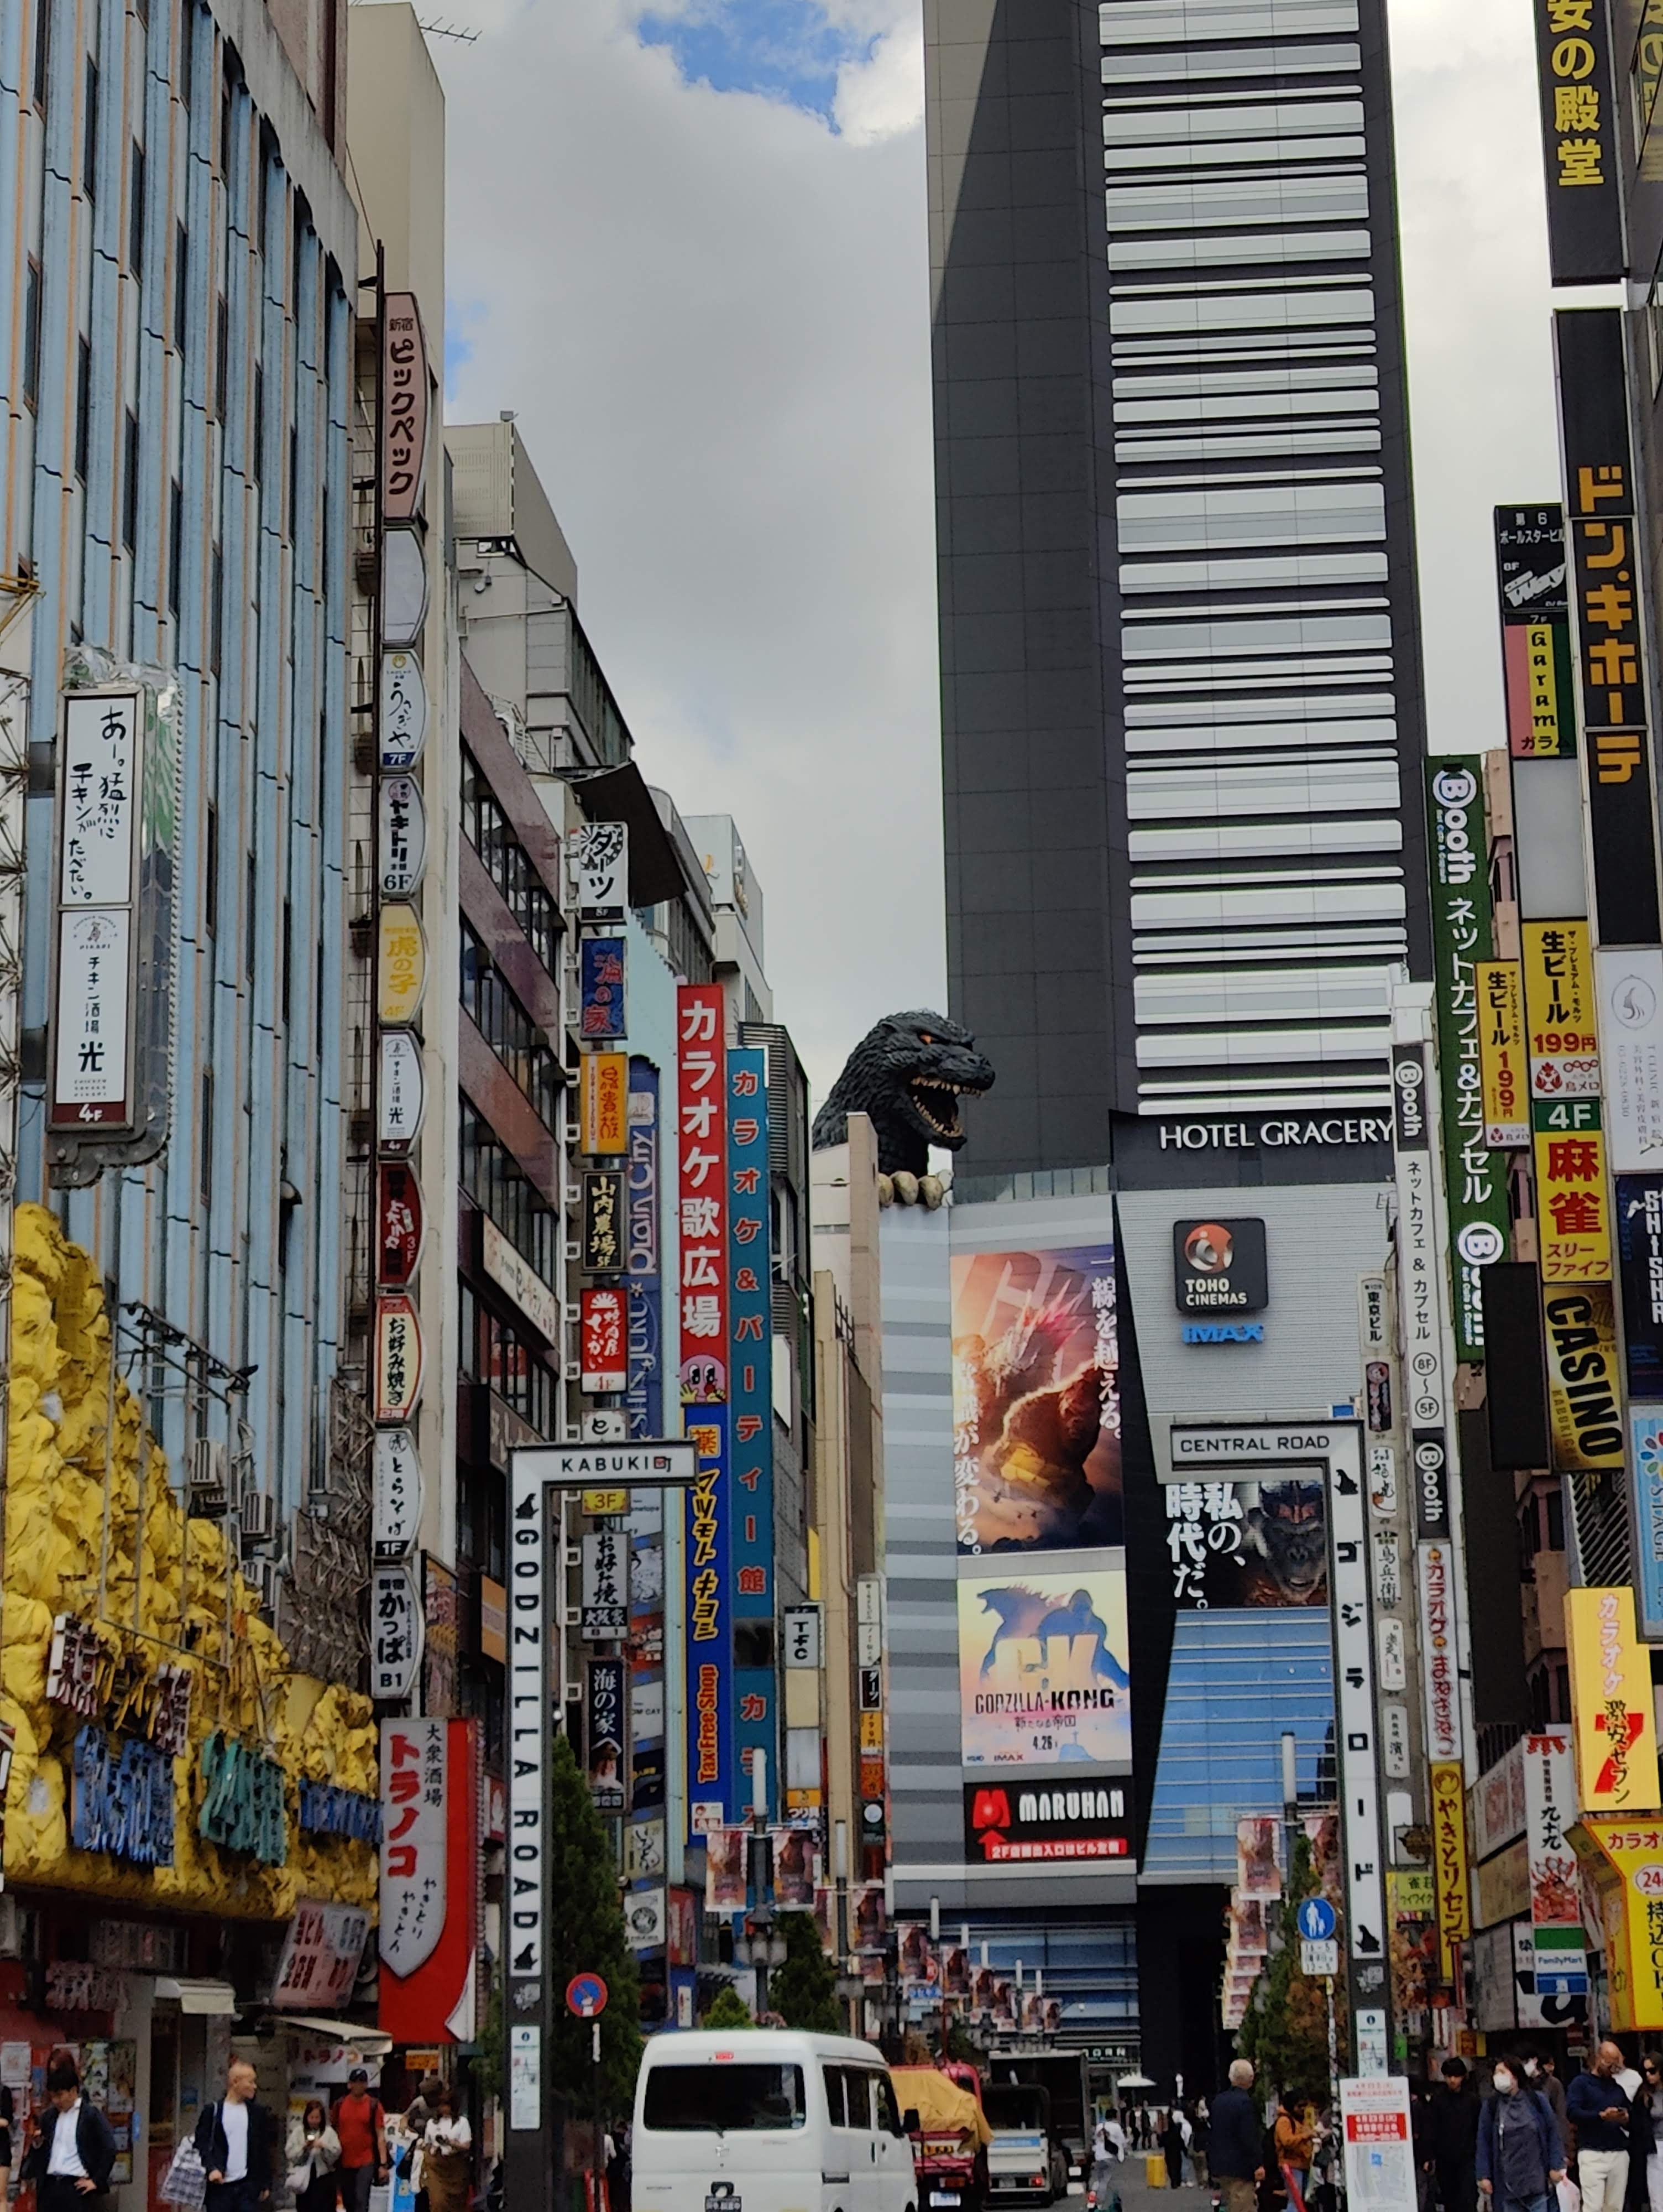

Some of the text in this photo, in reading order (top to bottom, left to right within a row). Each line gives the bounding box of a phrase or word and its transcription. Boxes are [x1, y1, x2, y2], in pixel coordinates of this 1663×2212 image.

[390, 318, 414, 331] 新宿
[1531, 631, 1556, 727] Garam
[389, 754, 407, 764] 7F
[1432, 769, 1478, 884] Booth
[385, 874, 414, 890] 6F
[1541, 931, 1570, 1024] 生ビール
[1487, 971, 1510, 1045] 生ビール
[79, 1041, 105, 1072] 光
[1534, 1032, 1597, 1053] 199円
[78, 1104, 103, 1121] 4F
[390, 1107, 405, 1124] 光
[1394, 1061, 1423, 1138] Booth
[1547, 1103, 1592, 1129] 4F
[1159, 1118, 1394, 1150] HOTEL GRACERY
[1407, 1161, 1425, 1250] ネットカフェ
[1547, 1139, 1602, 1236] 麻雀
[1547, 1243, 1594, 1259] スリー
[1184, 1277, 1230, 1293] TOHO
[1185, 1292, 1248, 1306] CINEMAS
[1368, 1291, 1383, 1342] 東京ビル
[1412, 1279, 1431, 1341] カプセル
[1546, 1295, 1624, 1459] CASINO
[1180, 1436, 1330, 1452] CENTRAL ROAD
[594, 1493, 618, 1510] 3F
[1415, 1442, 1445, 1522] Booth
[383, 1542, 402, 1555] 1F
[1427, 1564, 1447, 1634] カラオケ
[378, 1592, 406, 1665] かっぱ
[1598, 1594, 1624, 1697] カラオケ
[380, 1673, 402, 1687] B1
[975, 1688, 1115, 1714] GODZILLA KONG
[513, 1528, 540, 1929] GODZILLA ROAD
[698, 1665, 718, 1782] Tax Free Shop
[1337, 1540, 1374, 1881] ゴジラロード
[424, 1723, 443, 1808] 大衆酒場
[1604, 1700, 1630, 1804] 激安セブン
[388, 1734, 421, 1879] トラノコ
[1019, 1790, 1125, 1822] MARUHAN
[1540, 1807, 1562, 1851] 九十九
[1537, 1955, 1583, 1967] FamilyMart
